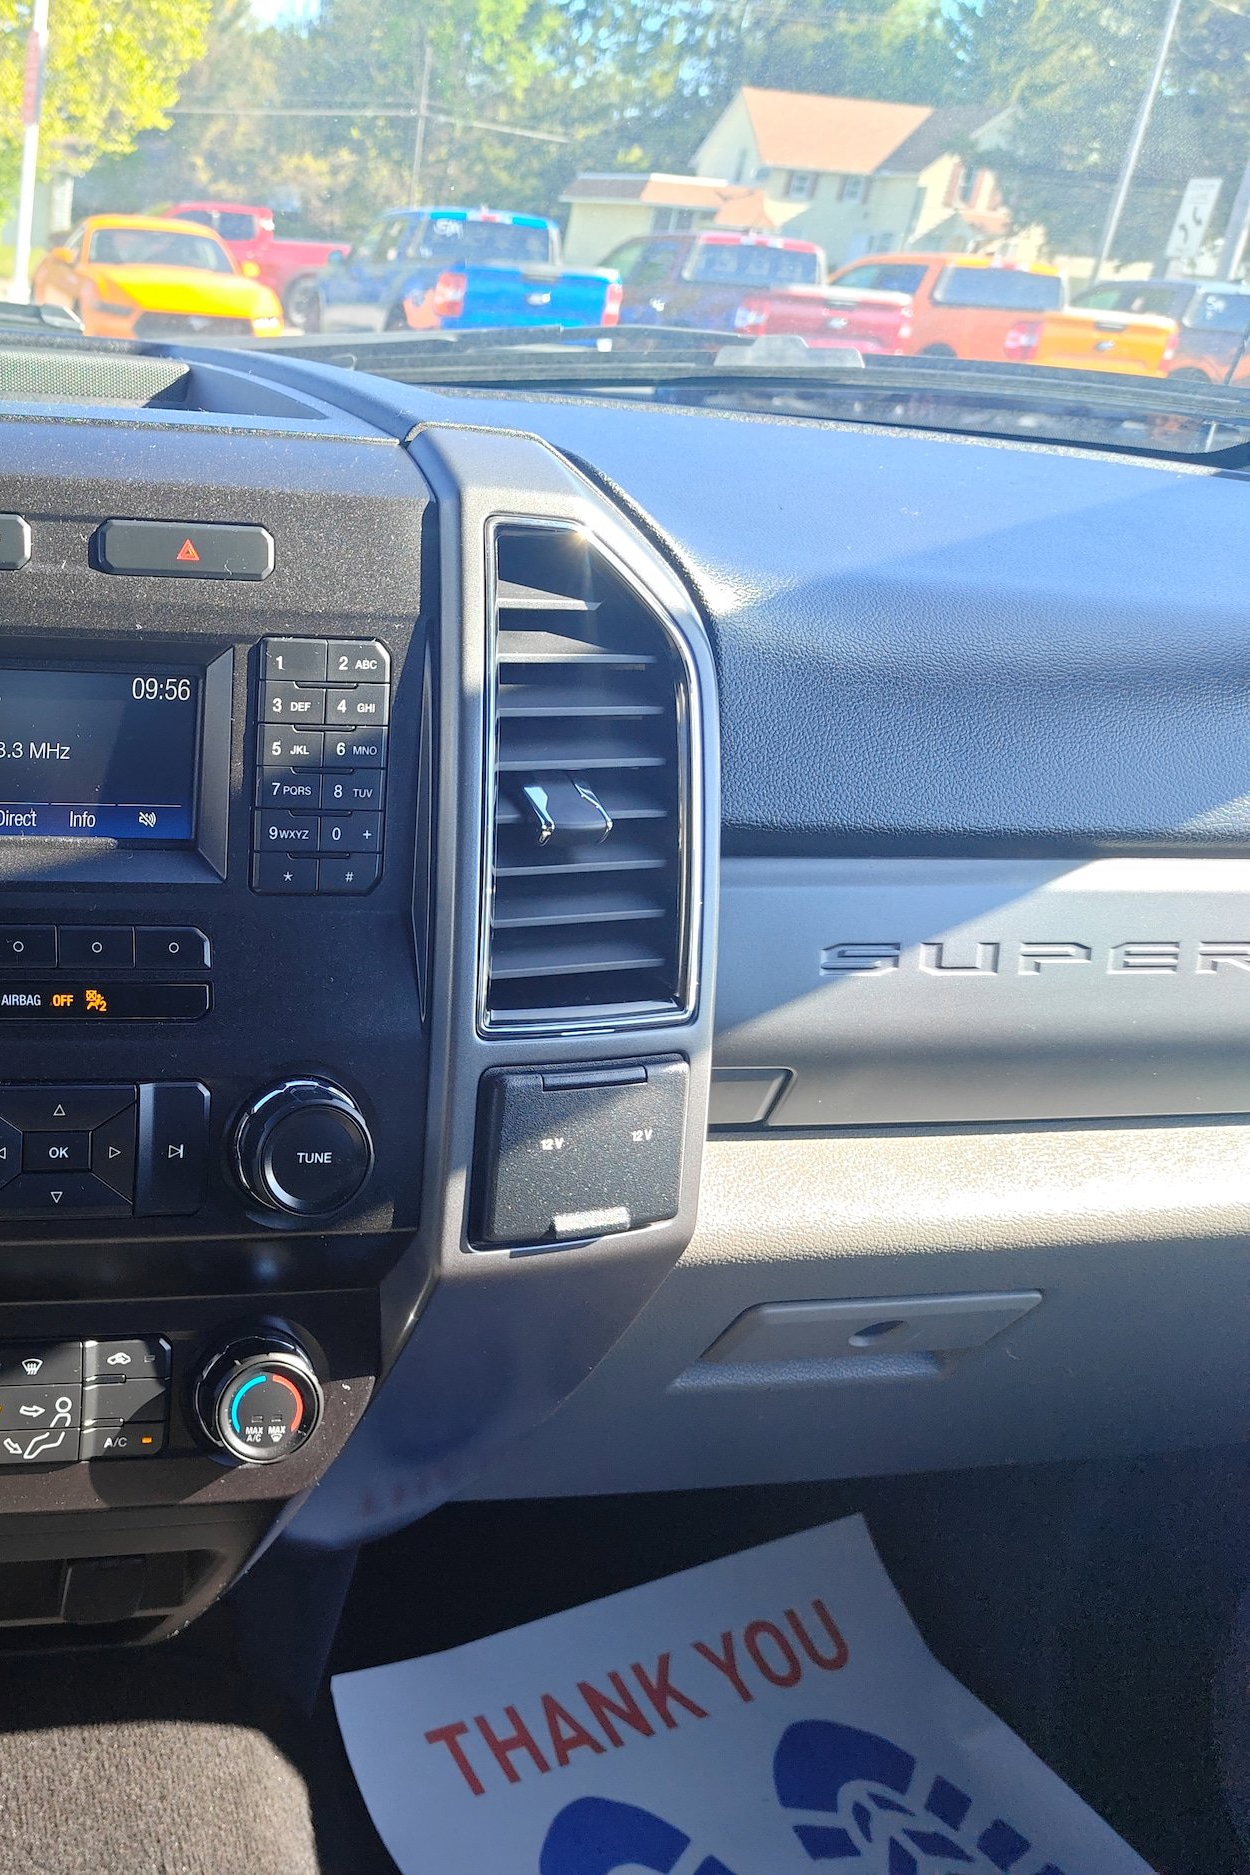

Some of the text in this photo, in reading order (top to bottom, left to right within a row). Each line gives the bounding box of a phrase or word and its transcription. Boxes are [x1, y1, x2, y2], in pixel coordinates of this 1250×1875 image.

[275, 655, 284, 670] 1
[339, 656, 378, 671] 2 ABC
[131, 677, 191, 701] 09:56
[272, 697, 312, 712] 3 DEF
[337, 699, 376, 714] 4 GHI
[29, 742, 71, 760] MHz
[271, 741, 310, 756] 5 JKL
[336, 742, 378, 757] 6 MNO
[271, 782, 312, 796] 7 PQRS
[333, 784, 374, 799] 8 TUV
[69, 810, 96, 828] Info
[268, 826, 310, 840] 9 WXYZ
[332, 827, 341, 841] 0
[819, 941, 1250, 976] SUPER
[1, 994, 42, 1007] AIRBAG
[52, 994, 74, 1007] OFF
[47, 1146, 70, 1160] OK
[296, 1151, 333, 1165] TUNE
[245, 1426, 264, 1435] MAX
[268, 1425, 287, 1435] MAX
[103, 1436, 128, 1449] A/C
[246, 1434, 262, 1442] A/C
[425, 1599, 851, 1797] THANK YOU
